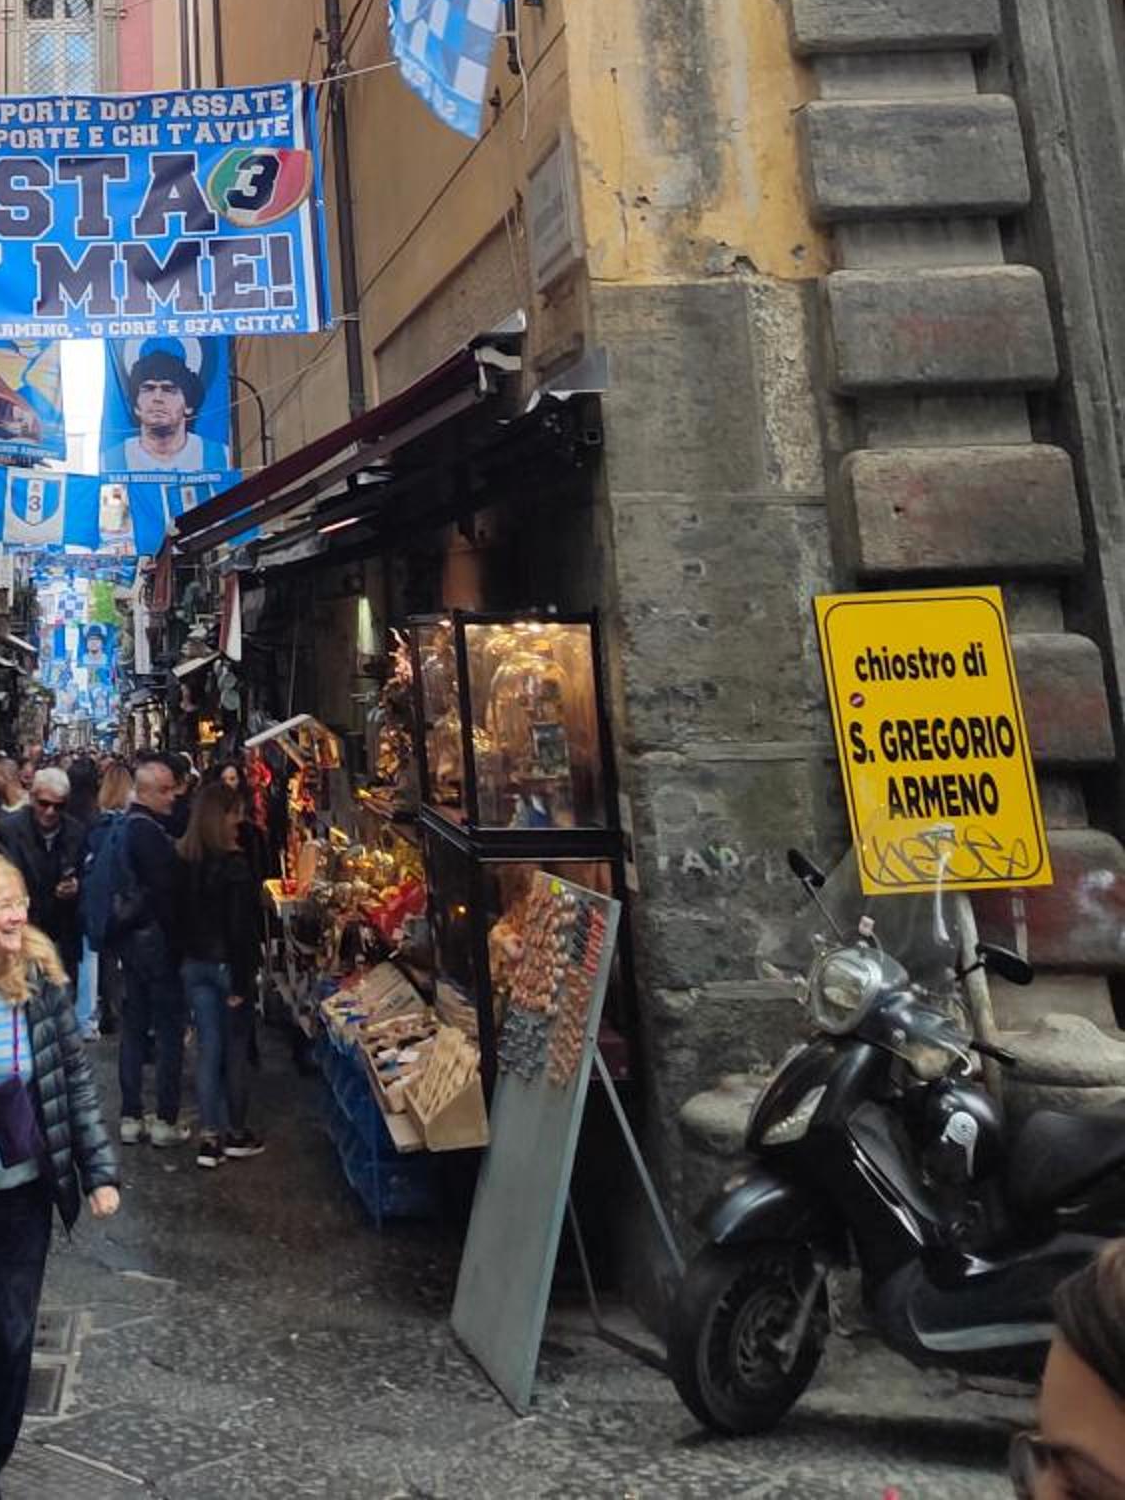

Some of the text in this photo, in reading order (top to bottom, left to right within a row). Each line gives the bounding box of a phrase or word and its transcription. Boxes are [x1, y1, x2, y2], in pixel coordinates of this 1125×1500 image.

[100, 100, 142, 121] DO'
[151, 89, 287, 119] PASSATE
[88, 126, 105, 148] E
[112, 124, 159, 147] CHI
[166, 114, 291, 145] T'AVUTE
[225, 151, 283, 213] 3
[34, 232, 297, 319] MME!
[109, 320, 157, 336] CORE
[854, 642, 988, 682] chiostro di
[849, 715, 1016, 764] S. GREGORIO
[888, 771, 999, 820] ARMENO
